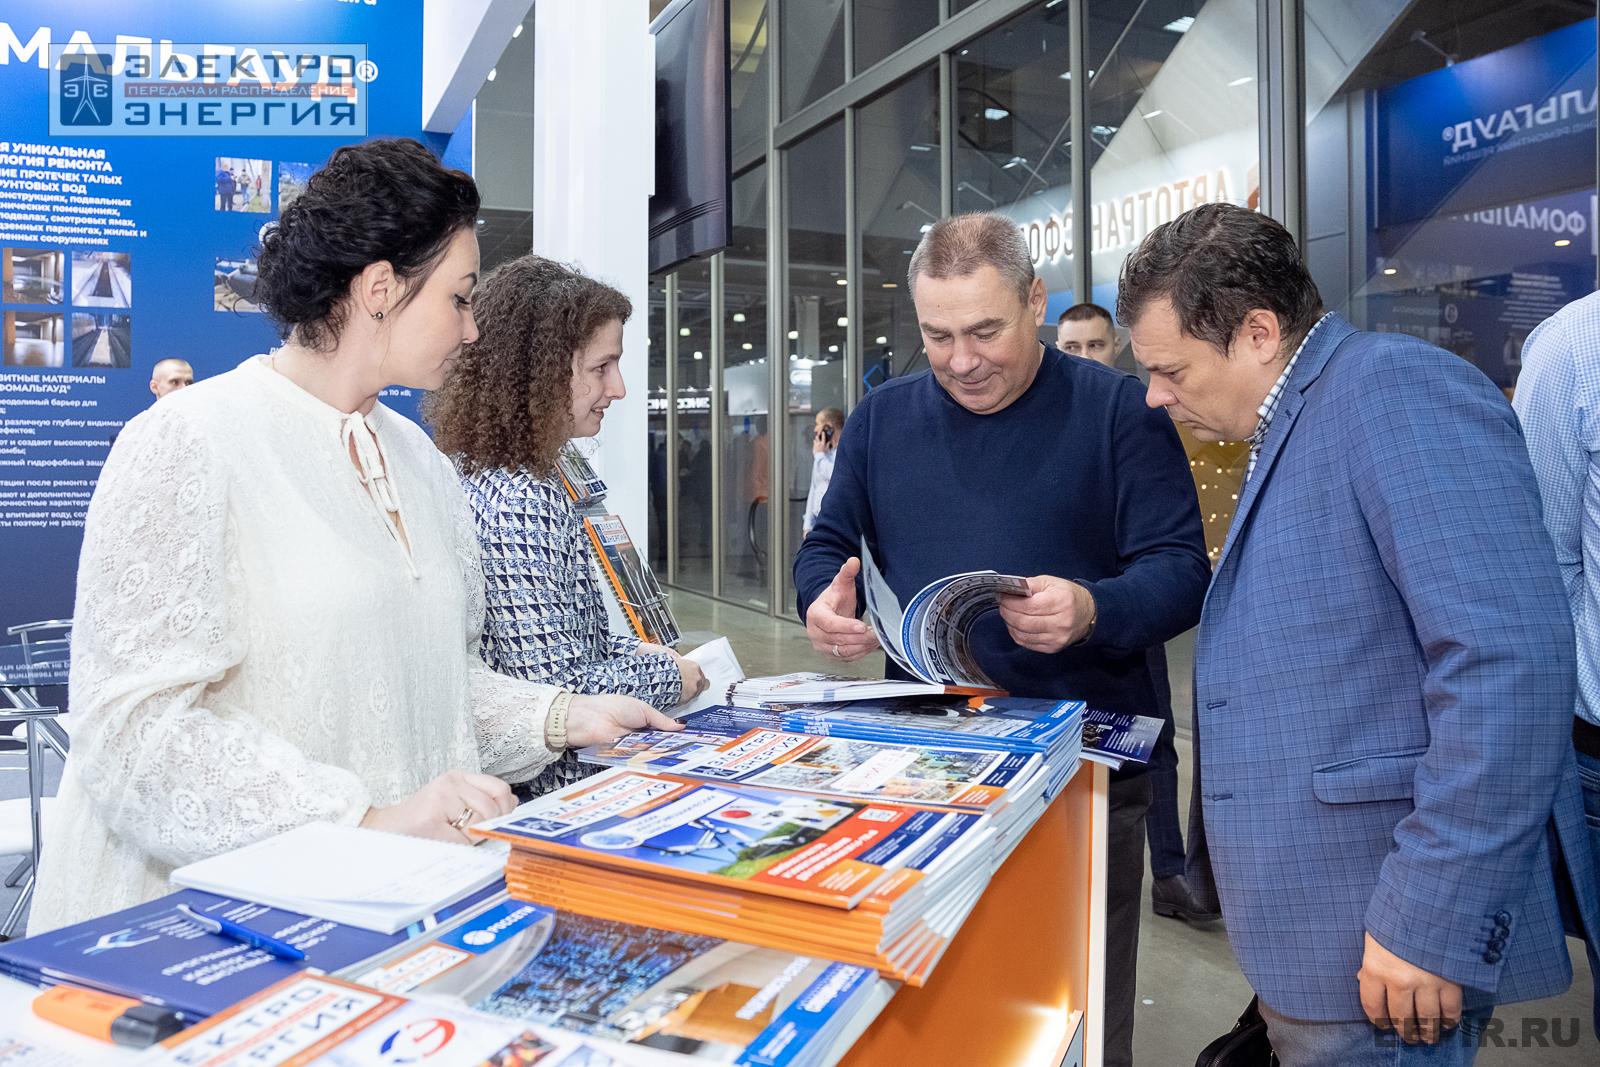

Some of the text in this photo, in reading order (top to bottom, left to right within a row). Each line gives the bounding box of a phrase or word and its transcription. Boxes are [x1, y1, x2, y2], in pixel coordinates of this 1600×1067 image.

[12, 143, 105, 160] УНИКАЛЬНАЯ
[48, 158, 112, 172] РЕМОНТА
[20, 169, 79, 182] ПРОТЕЧЕК
[82, 174, 122, 185] ТАЛЫХ
[62, 183, 87, 195] ВОД
[70, 196, 132, 207] подвальных
[53, 205, 120, 217] помещениях,
[51, 215, 107, 226] смотровых
[109, 219, 136, 228] ямах,
[46, 225, 102, 236] паркингах,
[104, 229, 138, 238] жилых
[40, 236, 109, 246] сооружениях
[42, 374, 106, 384] МАТЕРИАЛЫ
[51, 398, 80, 408] барьер
[5, 419, 50, 427] различную
[52, 419, 85, 427] глубину
[27, 459, 84, 468] гидрофобный
[53, 480, 88, 488] ремонта
[27, 491, 90, 499] дополнительно
[13, 520, 47, 528] поэтому
